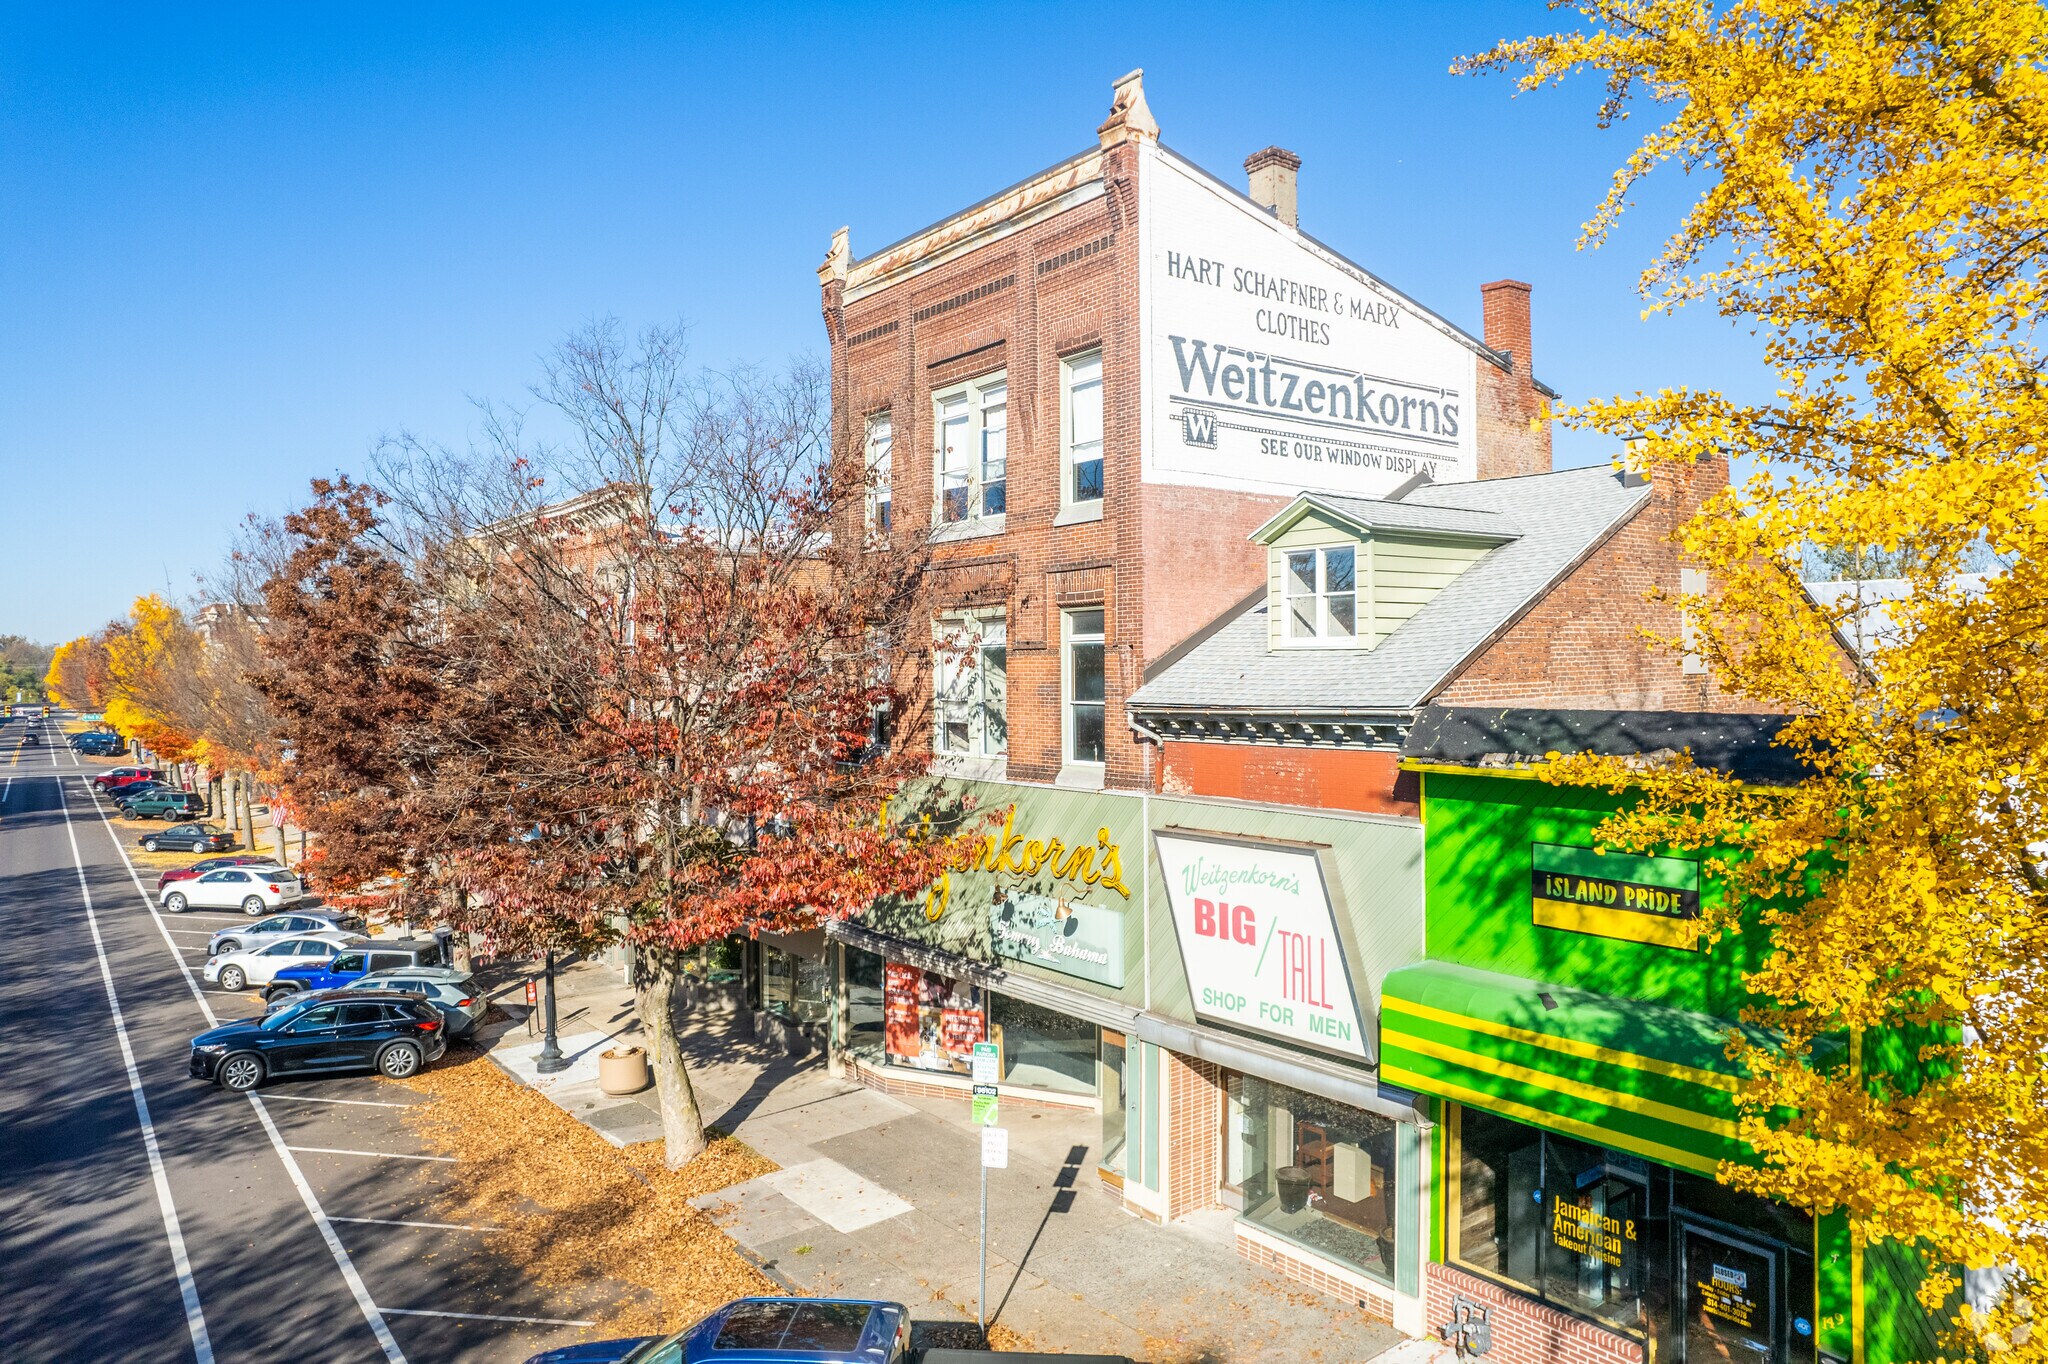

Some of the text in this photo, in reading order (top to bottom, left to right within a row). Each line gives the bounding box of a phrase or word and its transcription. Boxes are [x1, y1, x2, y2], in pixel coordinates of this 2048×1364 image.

[1168, 250, 1400, 330] HART SCHAFFNER & MARX
[1256, 309, 1331, 346] CLOTHES
[1168, 334, 1459, 438] Weitzenkorn's
[1186, 413, 1214, 442] W
[1261, 438, 1437, 478] SEE OUR WINDOW DISPLAY
[1182, 856, 1300, 896] Weitzenkorn's
[998, 921, 1108, 965] Tommy Bahama
[1194, 897, 1256, 946] BIG
[1278, 930, 1333, 1010] TALL
[1203, 987, 1351, 1041] SHOP FOR MEN
[1553, 1195, 1637, 1241] Jamaican &
[1553, 1213, 1622, 1254] American
[1553, 1232, 1622, 1267] Takeout Cuisine
[1715, 1266, 1734, 1279] CLOSED
[1822, 1313, 1845, 1330] 149
